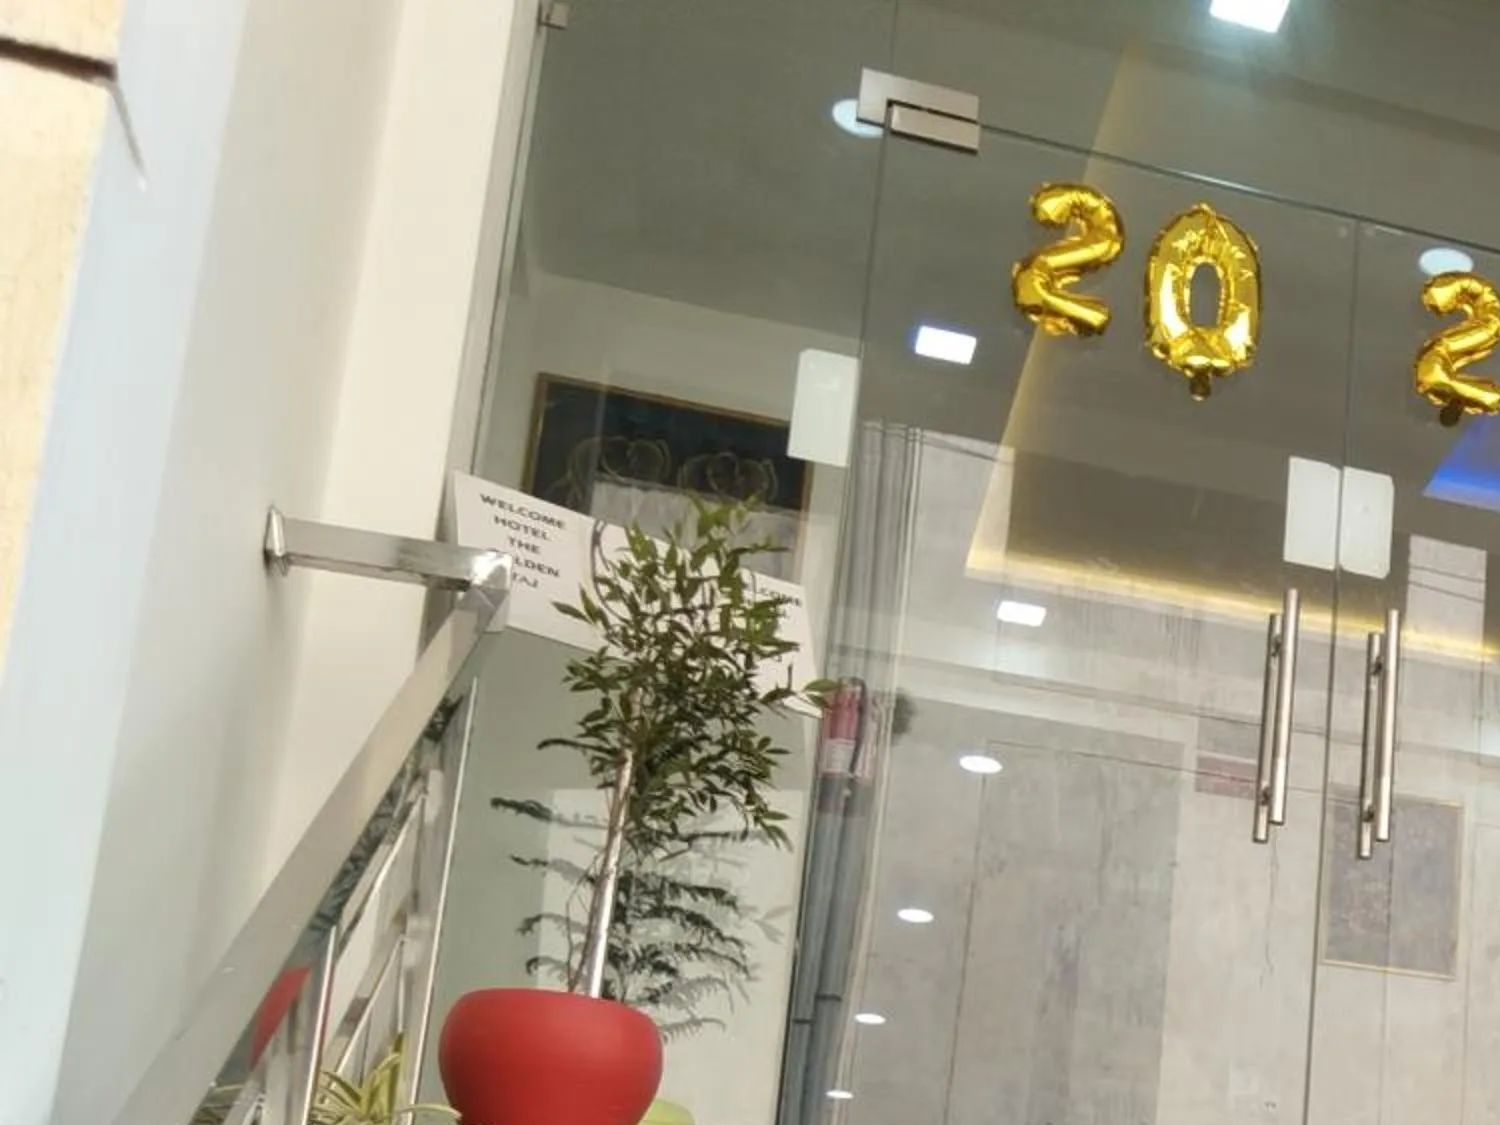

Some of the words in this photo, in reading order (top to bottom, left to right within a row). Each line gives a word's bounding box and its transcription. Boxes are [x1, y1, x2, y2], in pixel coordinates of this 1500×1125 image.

[480, 493, 565, 529] WELCOME
[494, 515, 550, 541] HOTEL
[508, 536, 541, 554] THE
[513, 555, 560, 578] LDEN
